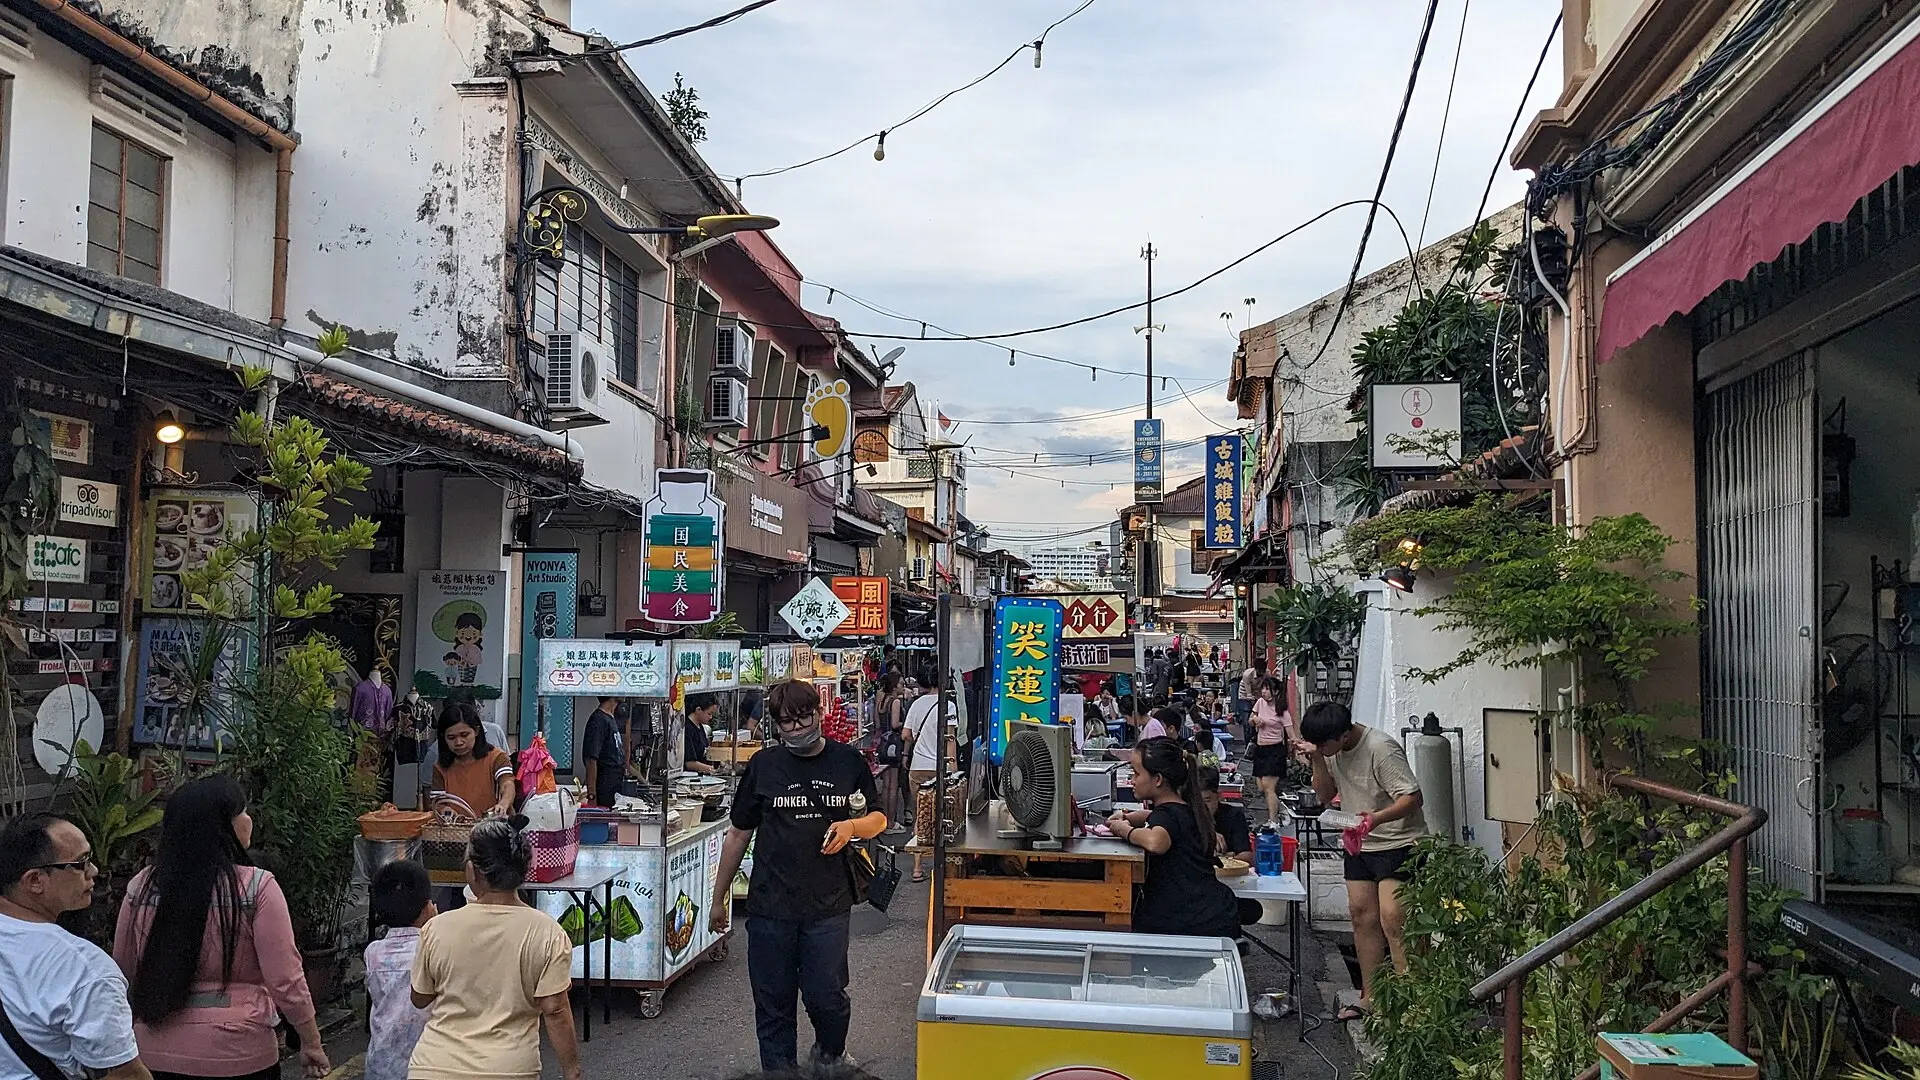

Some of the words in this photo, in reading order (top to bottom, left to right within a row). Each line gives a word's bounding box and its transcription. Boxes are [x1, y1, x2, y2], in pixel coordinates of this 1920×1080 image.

[1214, 440, 1235, 544] 古城雞飯粒
[61, 501, 114, 519] tripadvisor
[55, 543, 81, 567] afc
[527, 560, 566, 571] NYONYA
[670, 526, 690, 617] 国民美食
[527, 573, 540, 583] Art
[541, 573, 567, 583] Studio
[788, 599, 841, 620] 竹碗蒸
[860, 581, 882, 629] 風味
[1071, 606, 1109, 628] 分行
[566, 651, 644, 661] 娘惹风味椰浆饭
[567, 660, 590, 669] Nyonya
[592, 660, 607, 668] Style
[609, 660, 623, 668] Nasi
[624, 660, 644, 669] Lemak
[811, 780, 835, 789] STREET
[773, 795, 808, 807] JONKER
[634, 881, 654, 899] Lah
[1780, 912, 1809, 936] MEDELI
